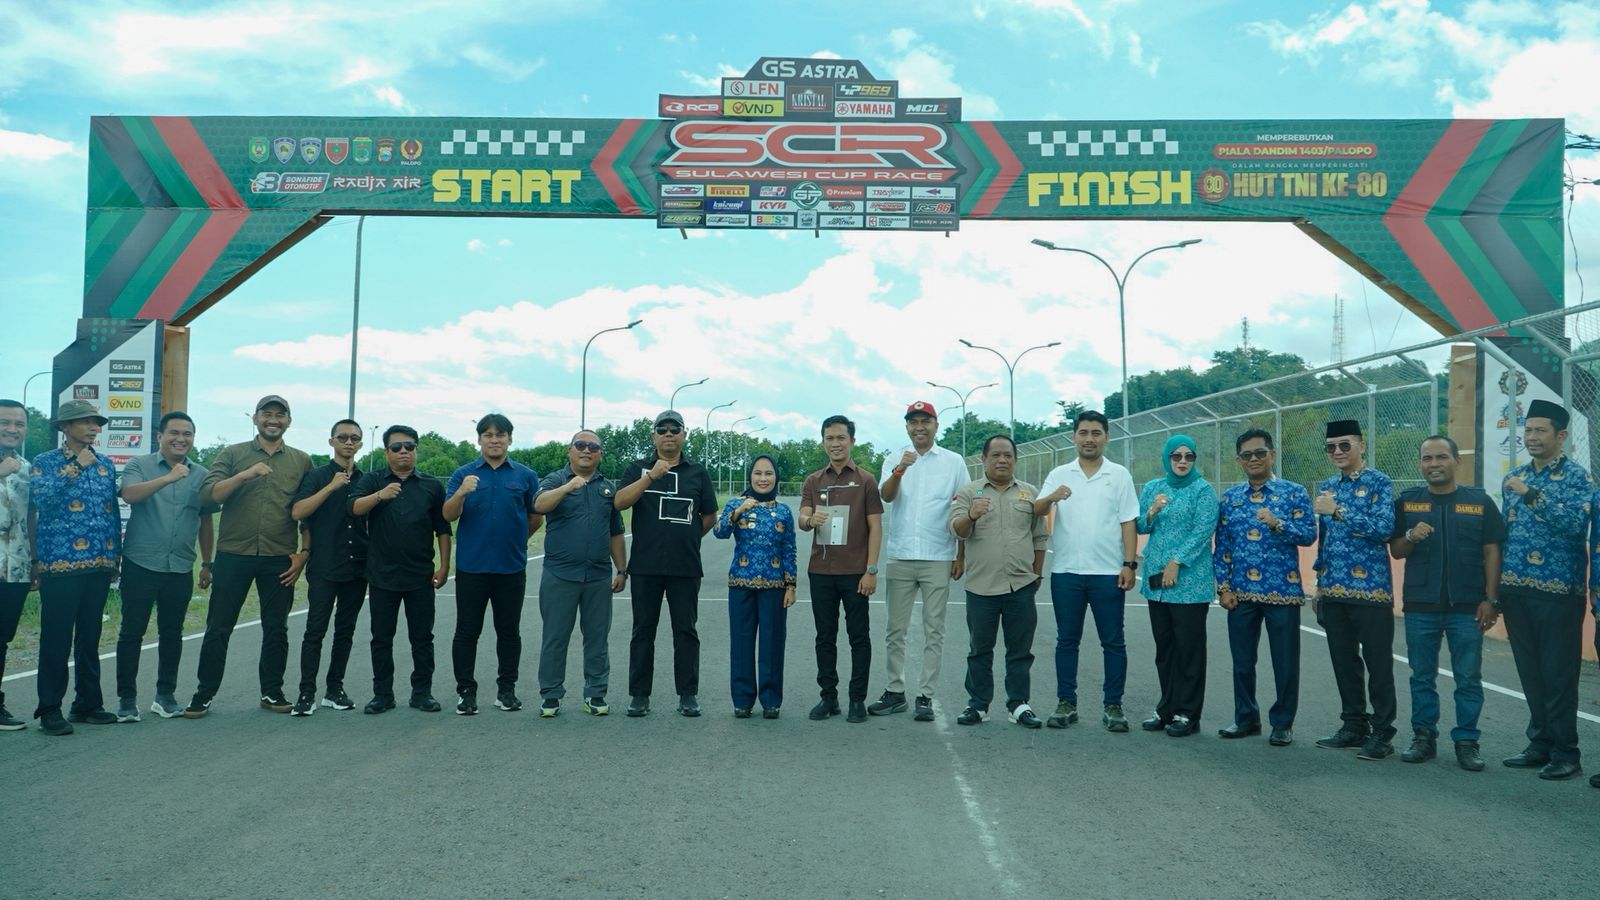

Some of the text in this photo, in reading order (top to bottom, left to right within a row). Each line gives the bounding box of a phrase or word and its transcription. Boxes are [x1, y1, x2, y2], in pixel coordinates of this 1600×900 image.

[762, 60, 859, 79] GS ASTRA
[749, 83, 779, 95] LFN
[686, 103, 719, 111] RCB
[850, 103, 893, 115] YAMAHA
[660, 120, 956, 169] SCR
[1219, 147, 1249, 155] PIALA
[1253, 147, 1298, 155] DANDIM
[675, 170, 943, 180] SULAWESI CUP RACE
[432, 169, 581, 203] START
[1028, 171, 1192, 206] FINISH
[1233, 172, 1387, 197] HUT TNI KE-80
[710, 187, 746, 195] PIRELLI
